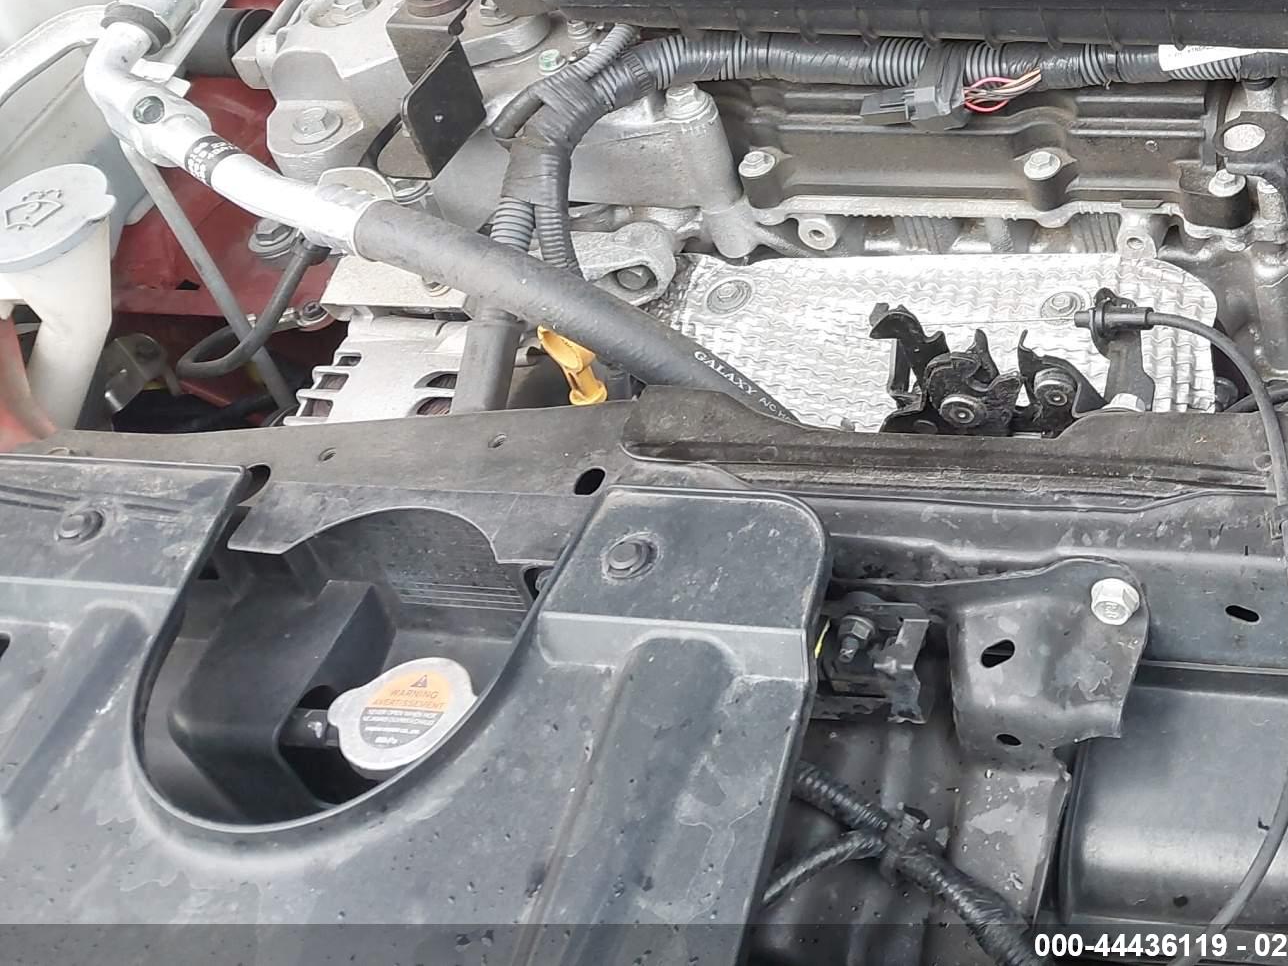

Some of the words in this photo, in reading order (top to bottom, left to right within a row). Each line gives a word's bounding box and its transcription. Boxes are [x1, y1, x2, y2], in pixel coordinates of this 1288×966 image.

[693, 351, 758, 396] GALAXY
[390, 689, 439, 699] WARNING
[373, 698, 446, 709] AVERTISSEMENT
